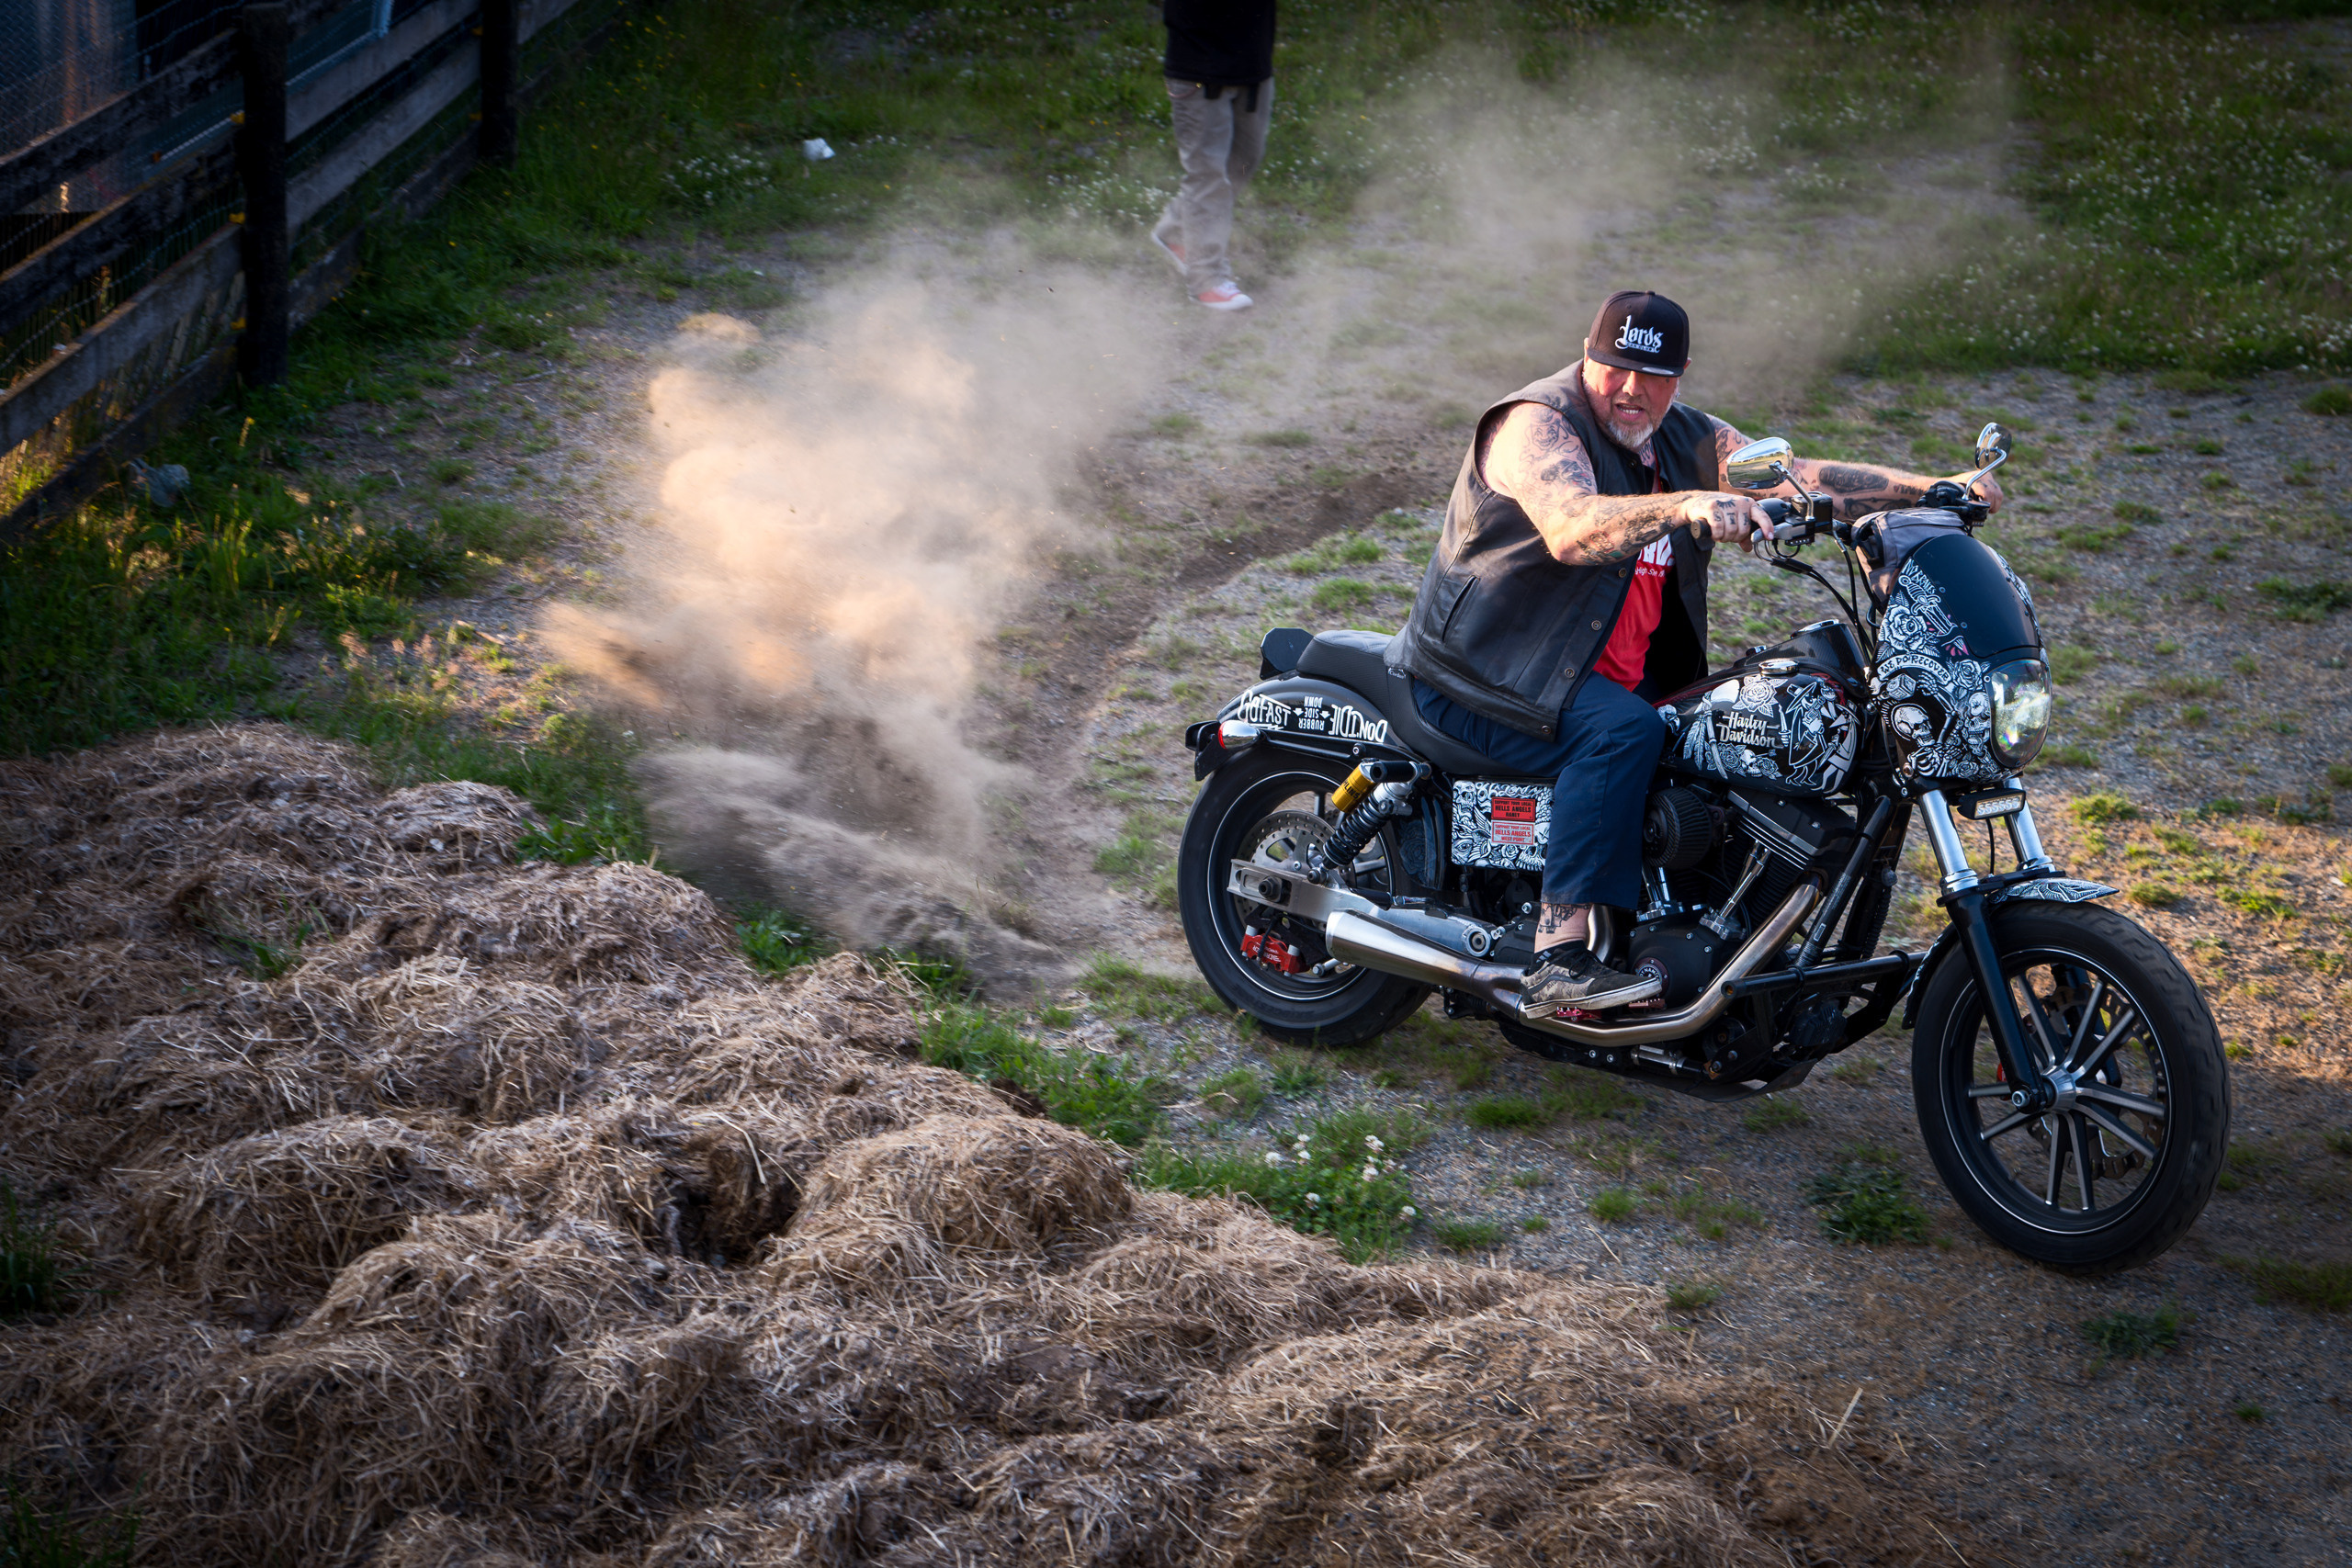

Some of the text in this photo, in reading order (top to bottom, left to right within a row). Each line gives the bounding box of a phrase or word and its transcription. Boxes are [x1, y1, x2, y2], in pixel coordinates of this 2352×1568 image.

[1880, 660, 1895, 674] WE
[1911, 655, 1950, 682] RECOVER
[1304, 695, 1323, 708] DOWN
[1304, 707, 1319, 718] SIDE
[1298, 717, 1325, 731] RUBBER
[1724, 712, 1778, 737] Harley
[1717, 723, 1781, 749] Davidson
